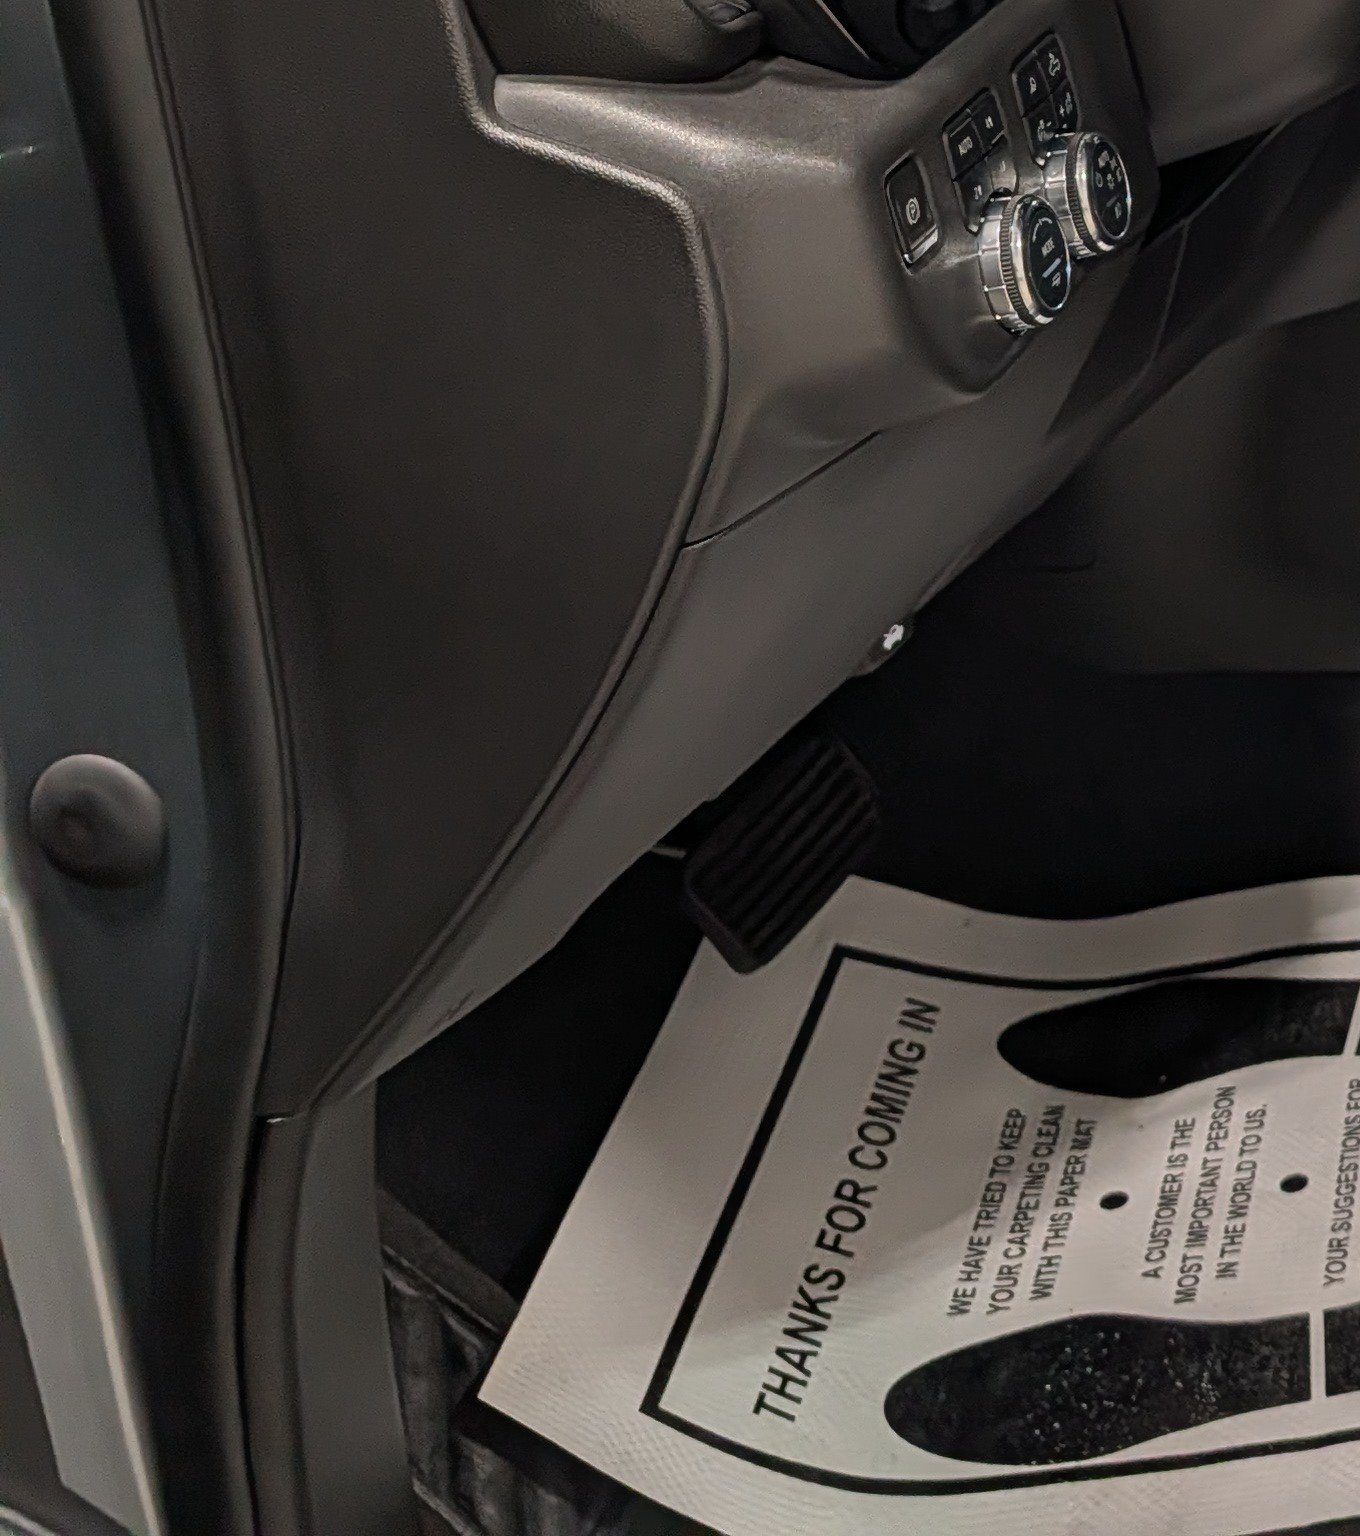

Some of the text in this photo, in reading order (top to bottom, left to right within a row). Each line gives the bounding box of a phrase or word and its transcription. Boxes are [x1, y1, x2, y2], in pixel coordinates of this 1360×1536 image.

[753, 997, 940, 1422] THANKS FOR COMING IN
[947, 1108, 1026, 1316] WE HAVE TRIED TO KEEP
[986, 1104, 1065, 1315] YOUR CARPETING CLEAN
[1029, 1118, 1097, 1301] WITH THIS PAPER MAT
[1141, 1117, 1196, 1279] A CUSTOMER IS THE
[1174, 1086, 1236, 1305] MOST IMPORTANT PERSON
[1215, 1104, 1267, 1279] IN THE WORLD TO US.
[1323, 1236, 1349, 1288] YOUR
